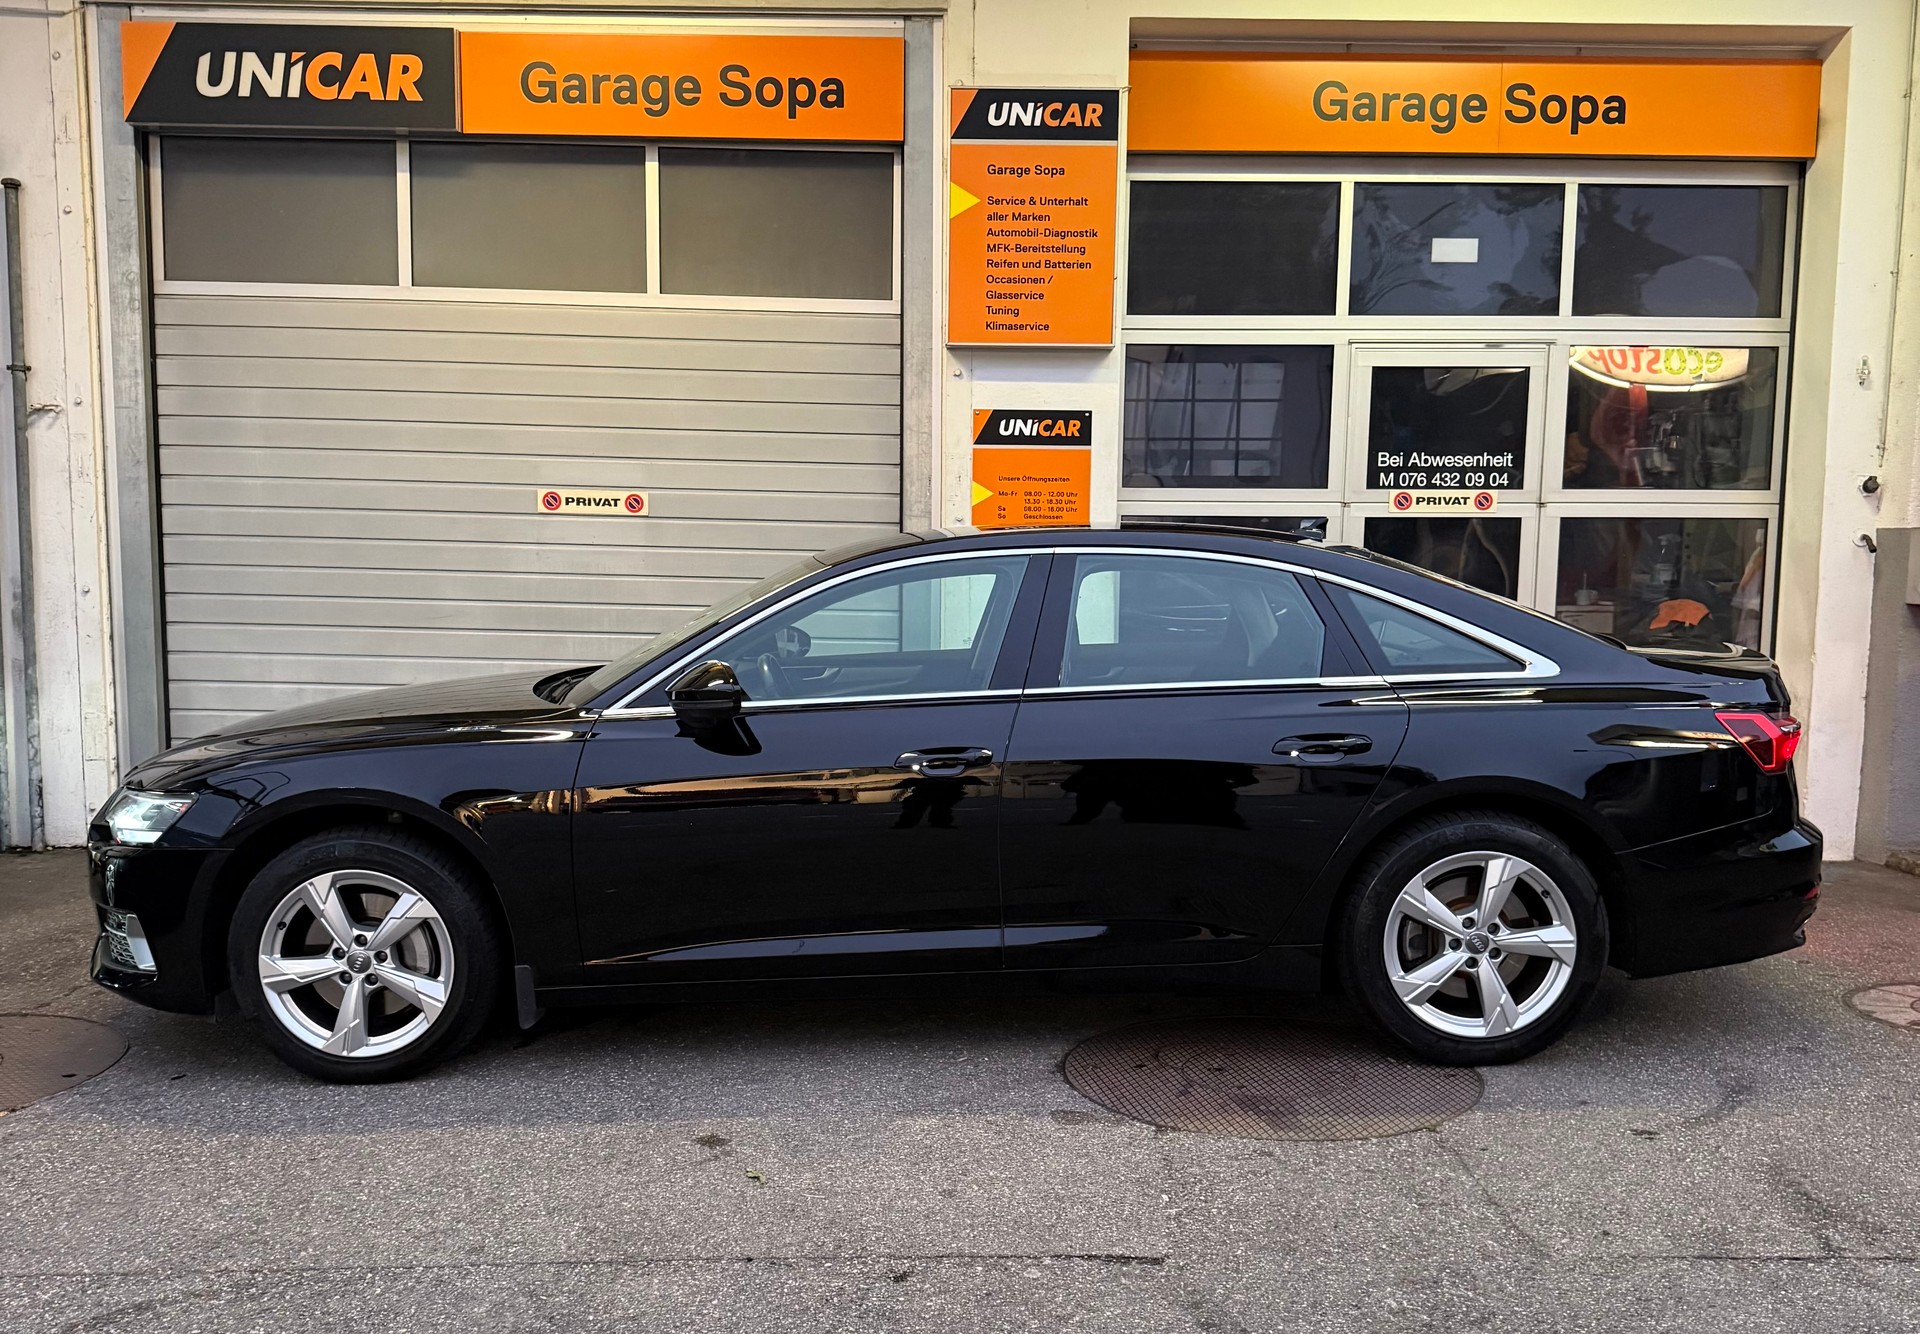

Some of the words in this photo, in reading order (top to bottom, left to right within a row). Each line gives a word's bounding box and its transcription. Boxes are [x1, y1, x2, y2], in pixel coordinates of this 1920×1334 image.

[519, 60, 701, 117] Garage
[718, 64, 845, 119] Sopa
[1312, 80, 1488, 134] Garage
[1504, 82, 1627, 135] Sopa
[987, 164, 1031, 178] Garage
[1034, 164, 1065, 178] Sopa
[987, 195, 1026, 206] Service
[1028, 196, 1037, 206] &
[1039, 197, 1089, 206] Unterhalt
[986, 212, 1009, 221] aller
[1011, 212, 1051, 222] Marken
[986, 228, 1098, 240] Automobil-Diagnostik
[986, 243, 1086, 256] MFK-Bereitstellung
[986, 259, 1020, 269] Reifen
[1022, 260, 1042, 269] und
[1044, 260, 1092, 269] Batterien
[986, 274, 1046, 285] Occasionen
[1047, 275, 1054, 285] /
[985, 290, 1045, 300] Glasservice
[985, 305, 1020, 318] Tuning
[985, 321, 1050, 331] Klimaservice
[1377, 452, 1404, 467] Bei
[1407, 452, 1514, 467] Abwesenheit
[1021, 474, 1071, 483] Öffnungszeiten
[1379, 472, 1395, 487] M
[1399, 472, 1427, 487] 076
[1431, 472, 1460, 487] 432
[1465, 472, 1485, 487] 09
[1489, 472, 1509, 487] 04
[565, 496, 621, 507] PRIVAT
[1415, 496, 1470, 506] PRIVAT
